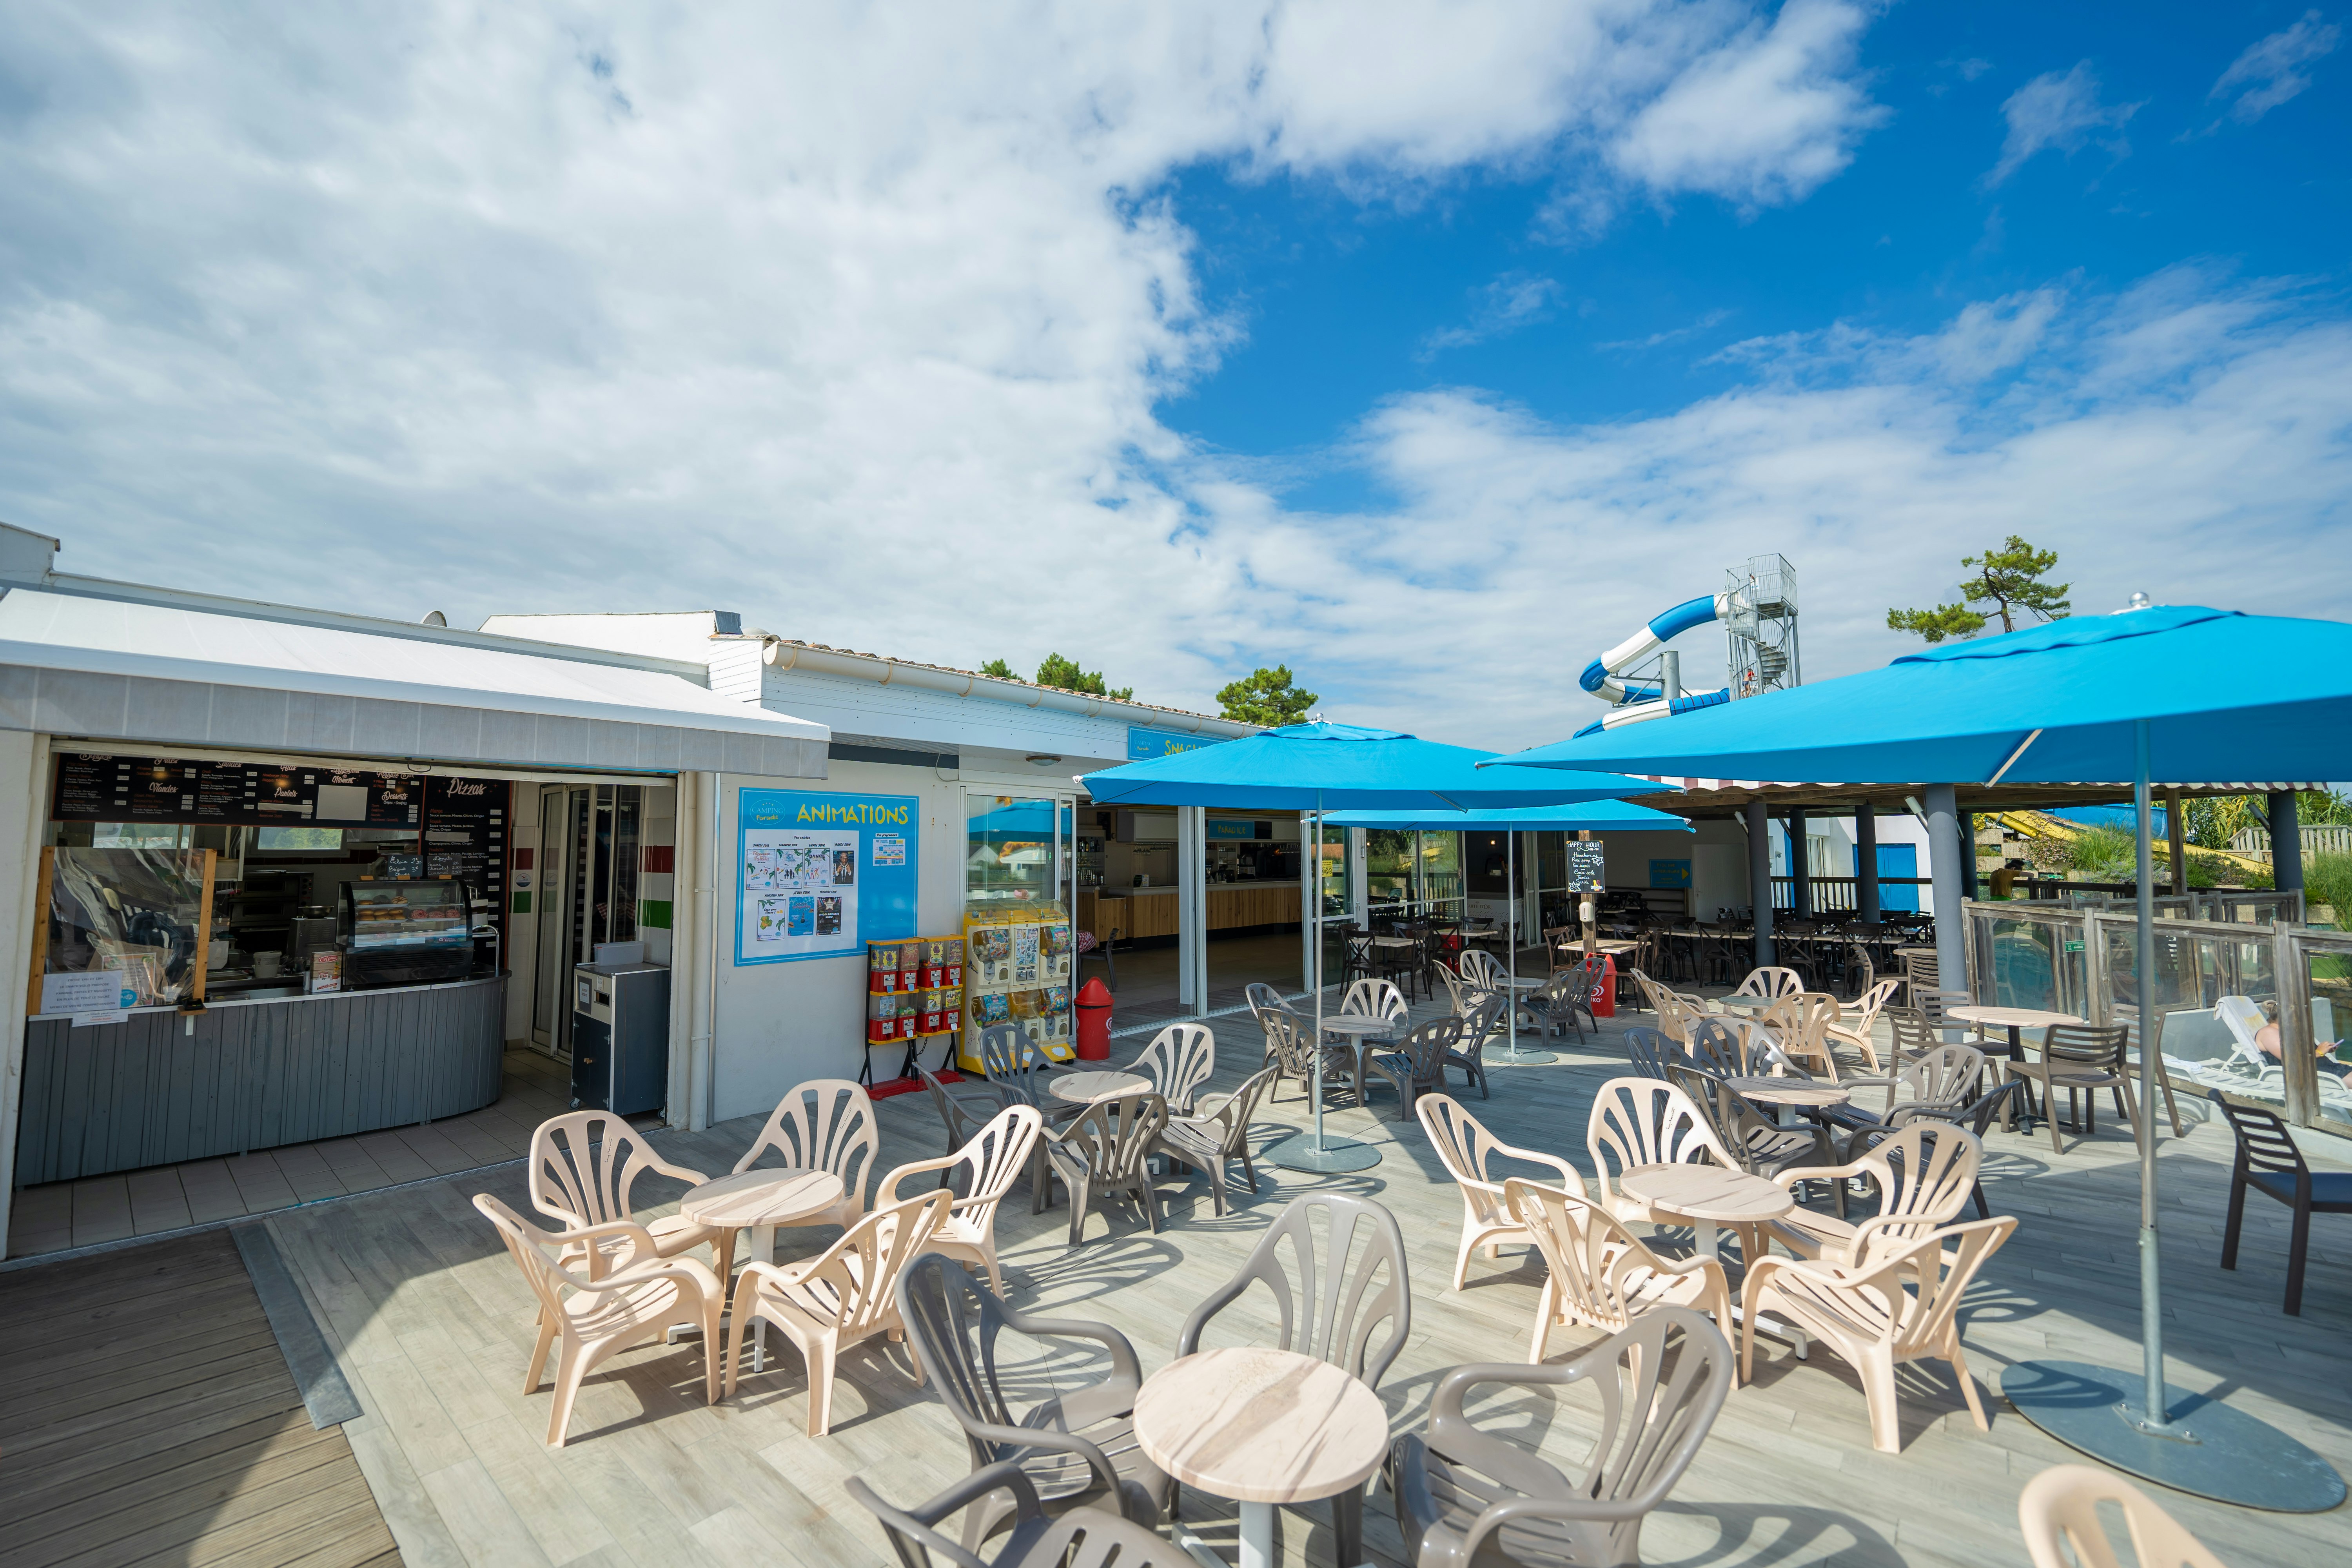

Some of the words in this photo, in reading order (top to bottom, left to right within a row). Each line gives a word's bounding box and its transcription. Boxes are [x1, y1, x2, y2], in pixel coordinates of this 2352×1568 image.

[1165, 740, 1201, 755] SNAC
[332, 775, 356, 784] Moment
[149, 782, 179, 793] Viandes
[274, 787, 298, 798] Paninis
[446, 777, 487, 798] Pizzas
[381, 791, 408, 801] Desserts
[797, 803, 908, 825] ANIMATIONS
